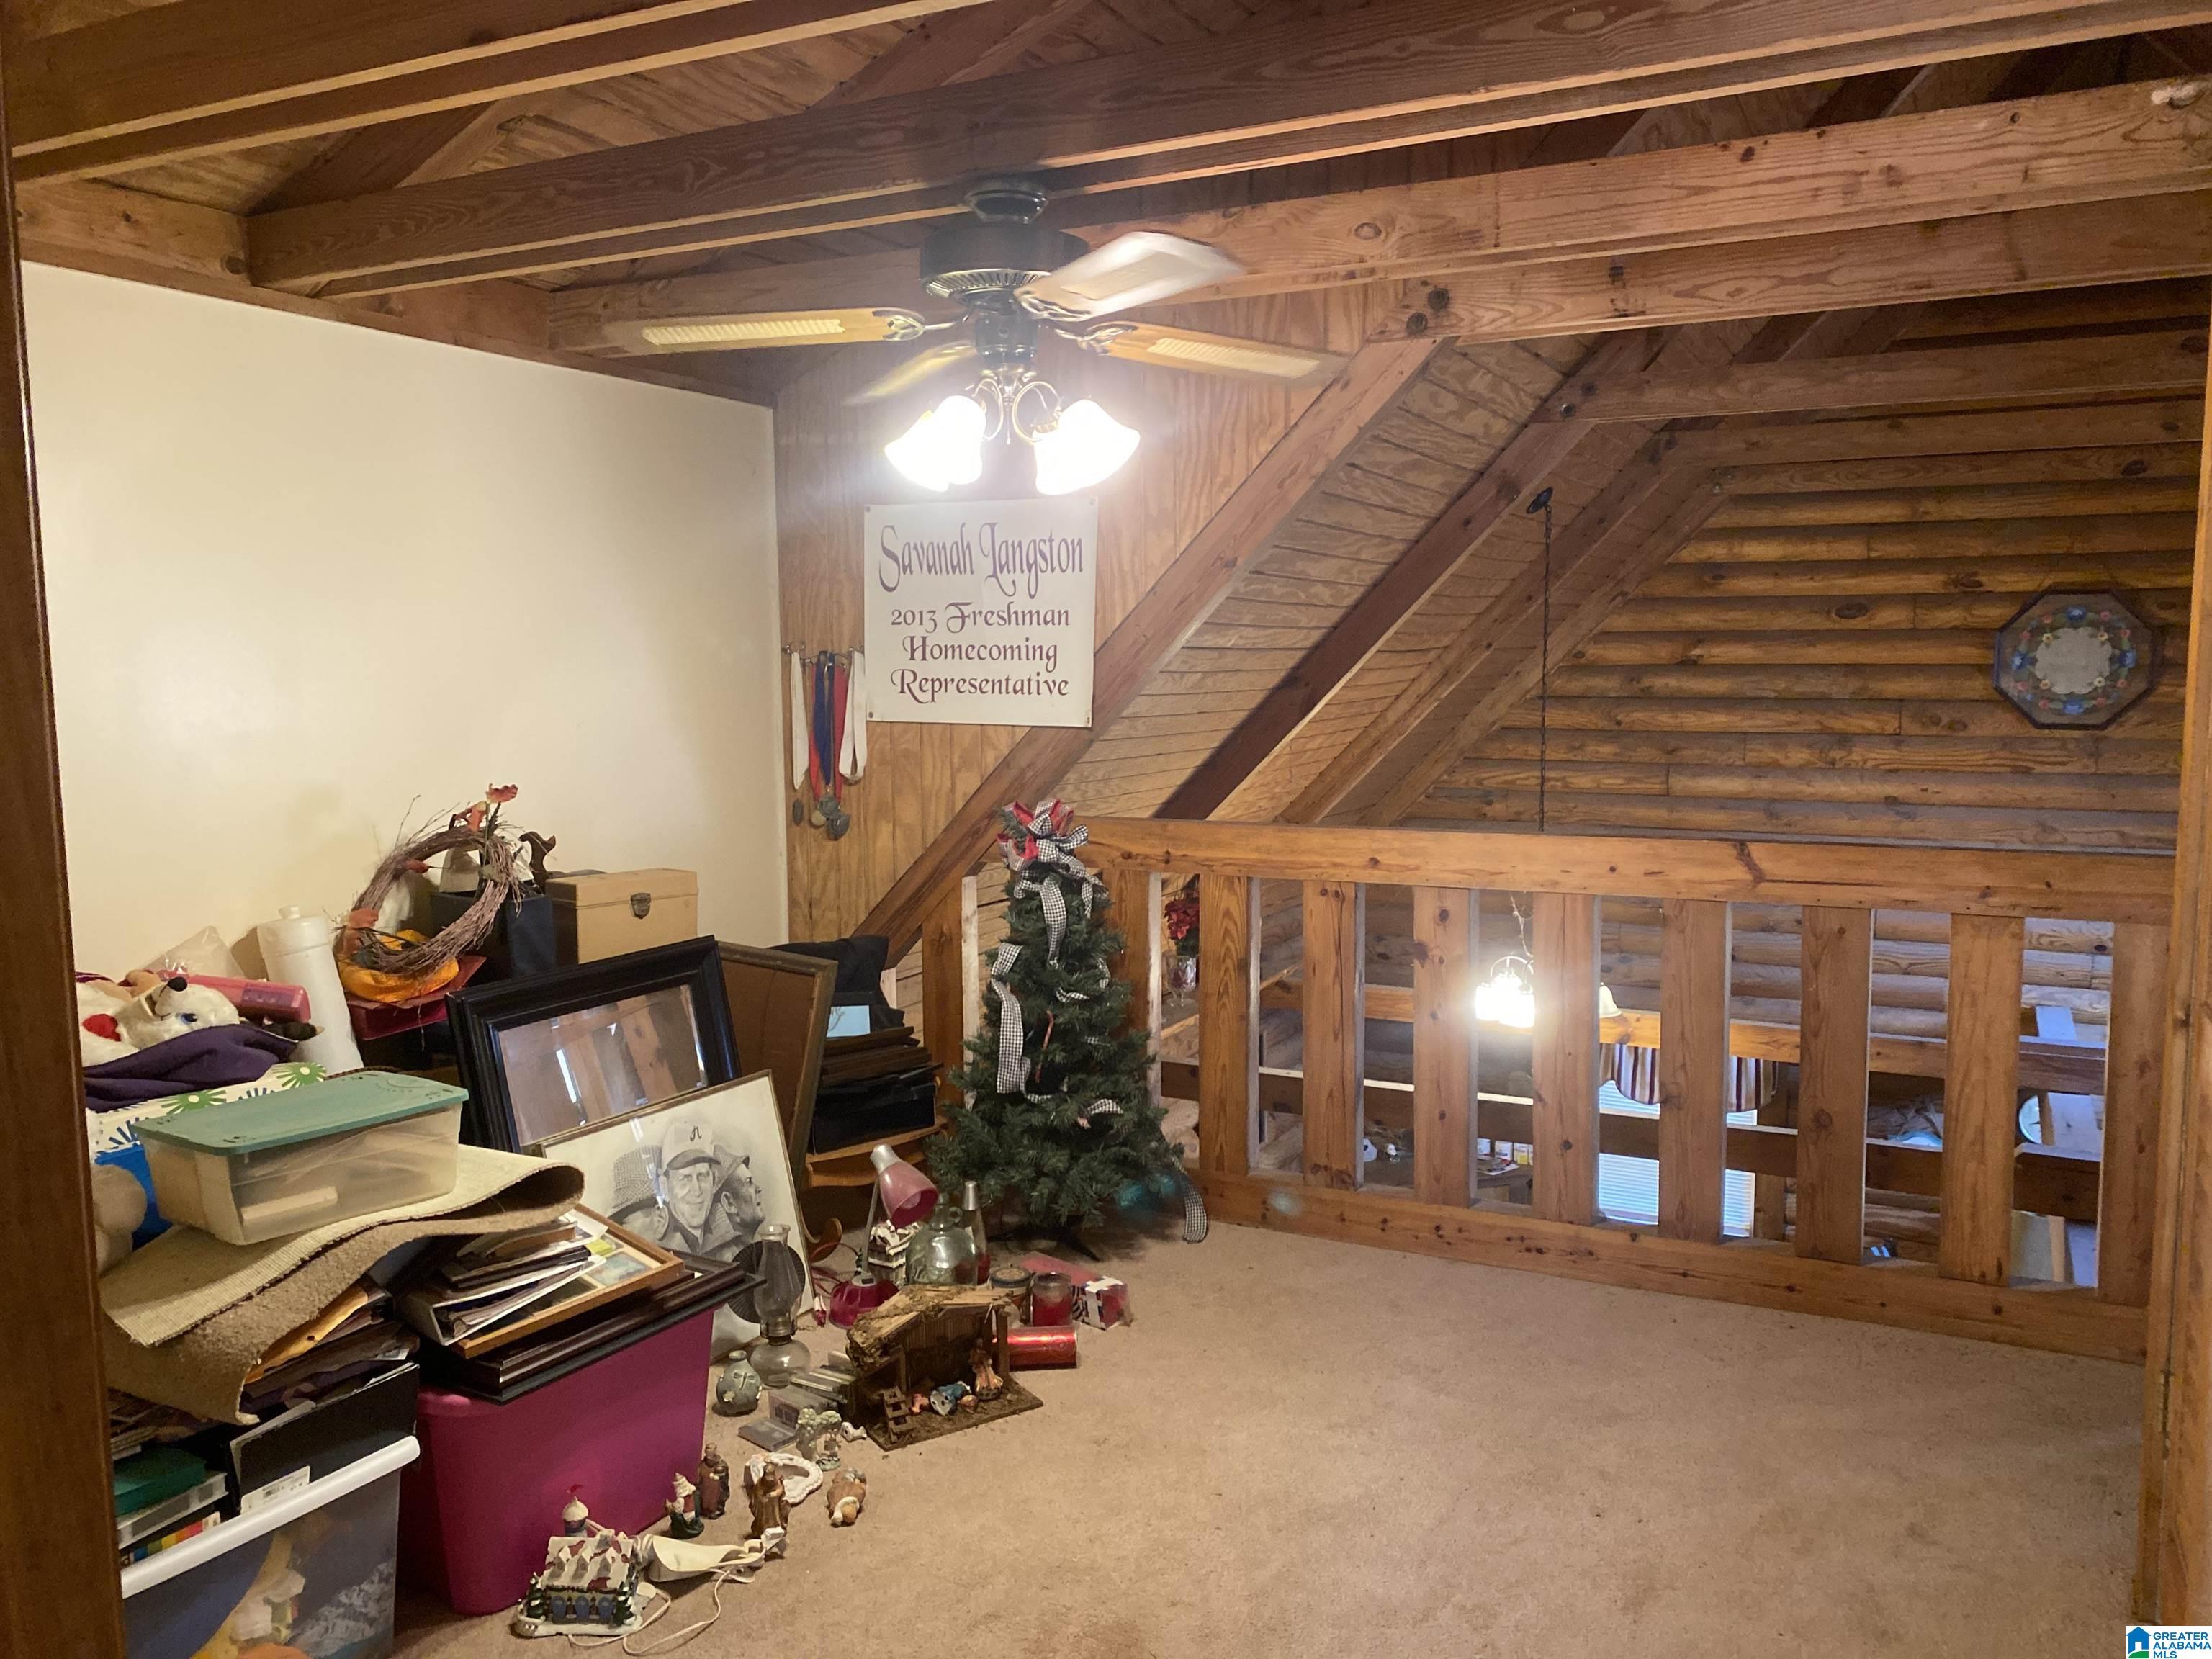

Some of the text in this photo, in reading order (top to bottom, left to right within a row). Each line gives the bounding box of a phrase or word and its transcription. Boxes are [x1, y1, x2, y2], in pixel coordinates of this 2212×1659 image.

[878, 521, 1084, 599] Savanah Langston
[891, 601, 1070, 634] 2013 Freshman
[902, 635, 1058, 673] Homecoming
[890, 668, 1069, 704] Representative
